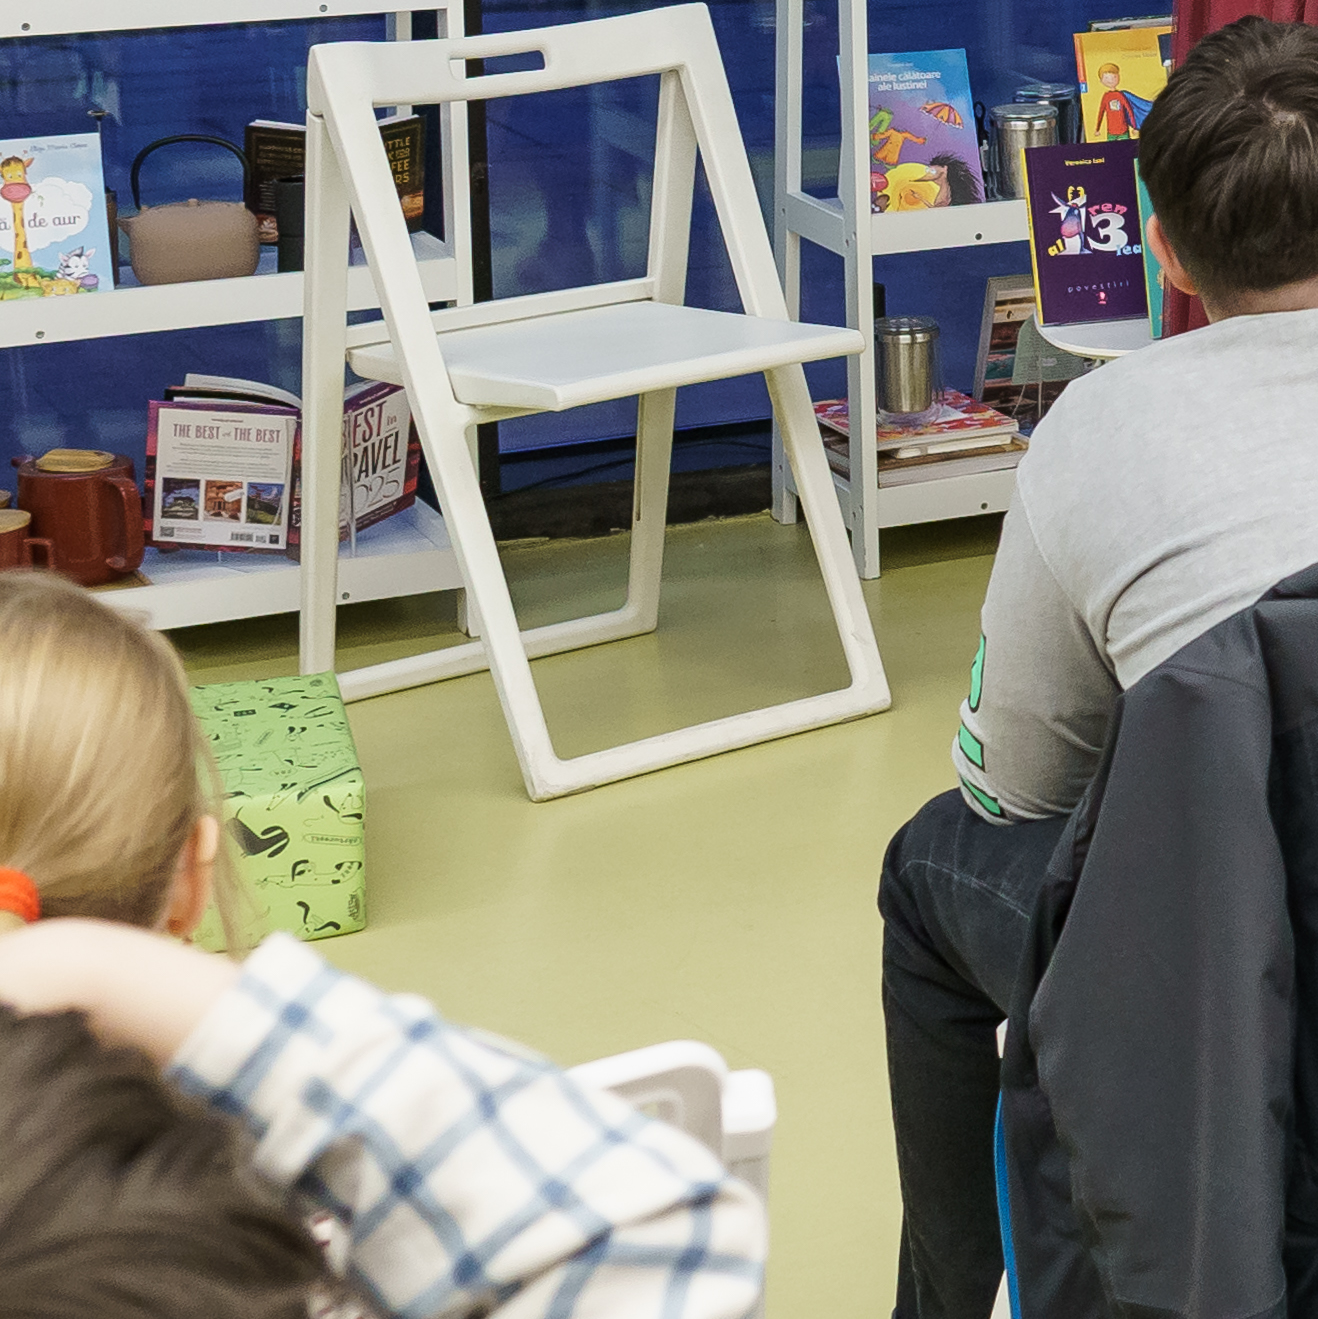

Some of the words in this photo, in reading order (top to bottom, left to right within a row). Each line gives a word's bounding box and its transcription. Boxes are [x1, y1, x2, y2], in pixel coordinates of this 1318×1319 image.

[868, 72, 897, 82] ainele
[878, 82, 892, 91] ale
[893, 80, 927, 91] Iustinei
[28, 212, 48, 229] de
[52, 215, 81, 227] aur
[1048, 239, 1066, 257] al
[173, 423, 192, 438] THE
[195, 425, 221, 440] BEST
[234, 427, 252, 442] THE
[255, 428, 281, 443] BEST
